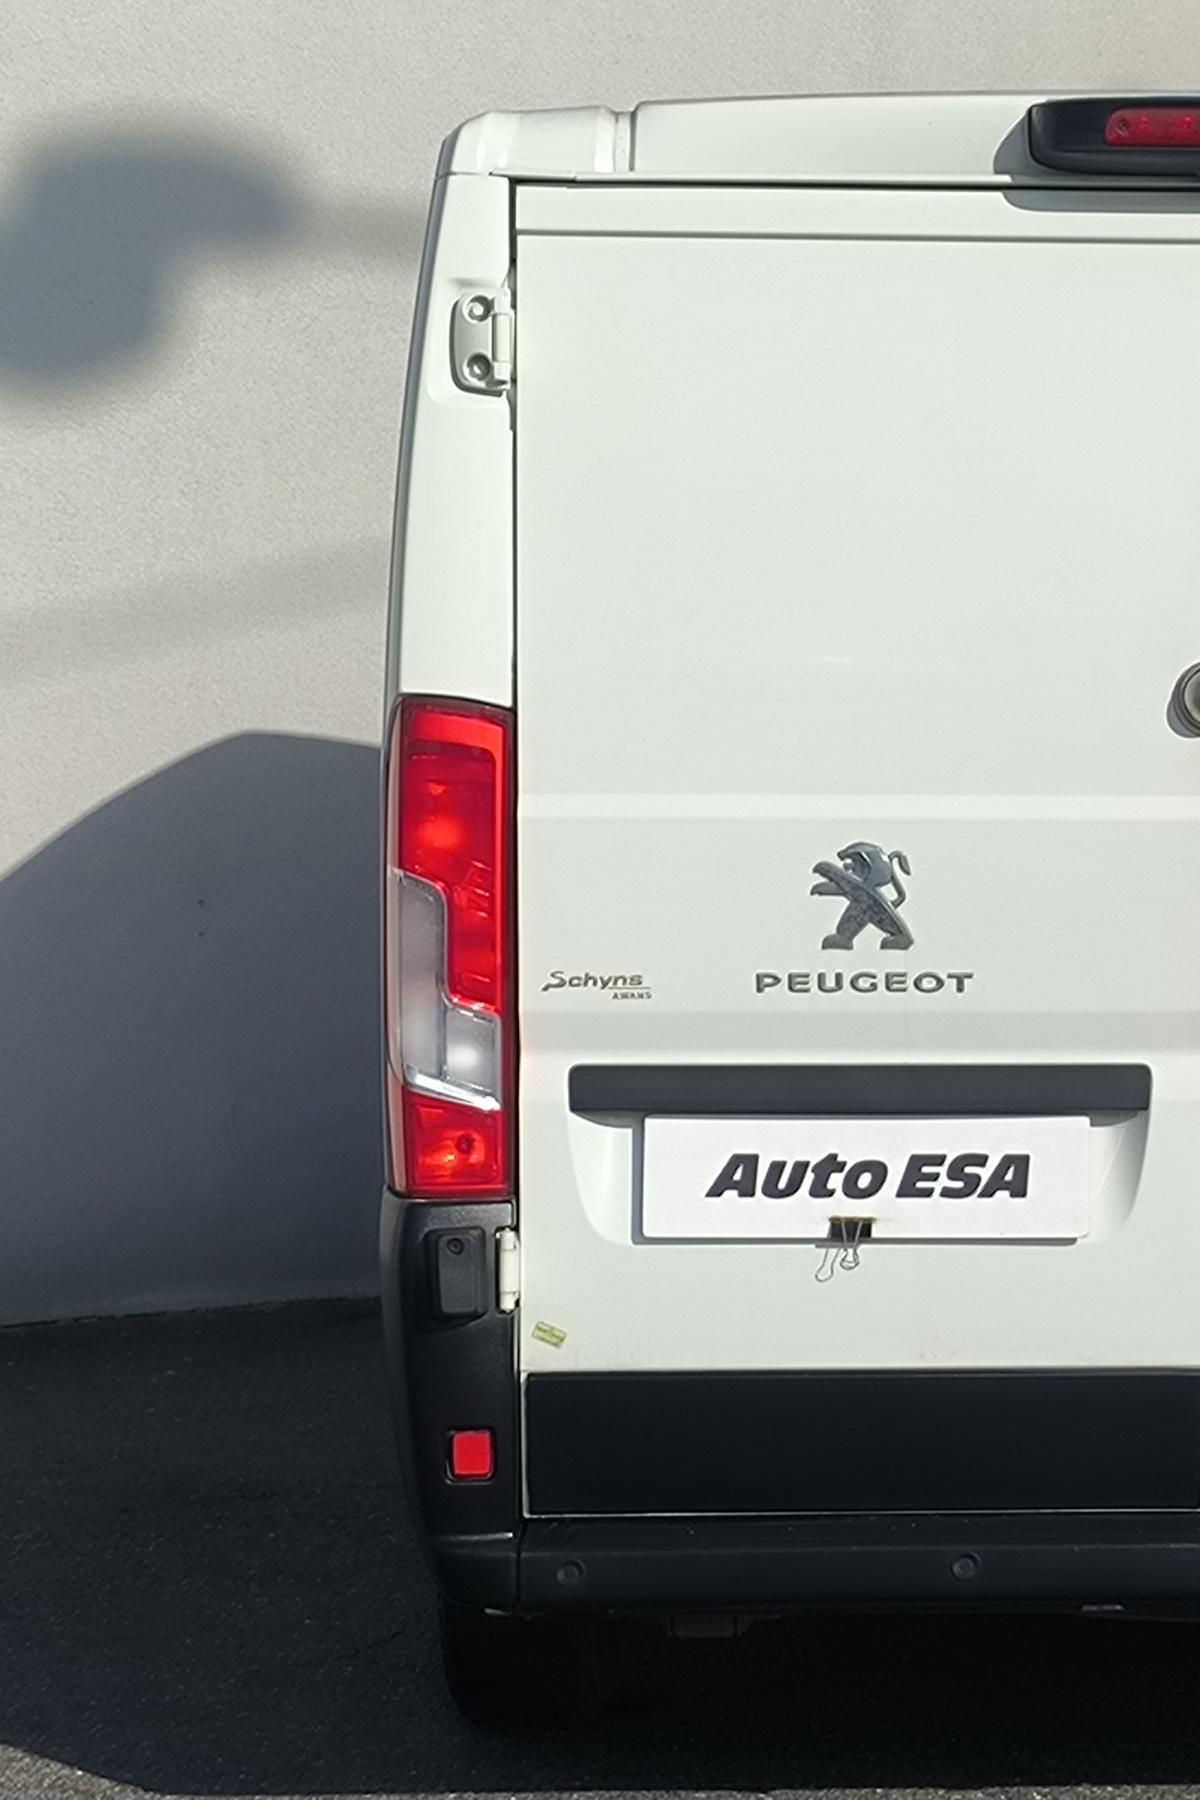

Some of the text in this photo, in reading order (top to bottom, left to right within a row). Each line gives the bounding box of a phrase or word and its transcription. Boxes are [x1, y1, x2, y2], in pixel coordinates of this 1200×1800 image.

[541, 970, 643, 992] Schyns
[755, 971, 974, 994] PEUGEOT
[704, 1153, 1031, 1200] Auto ESA
